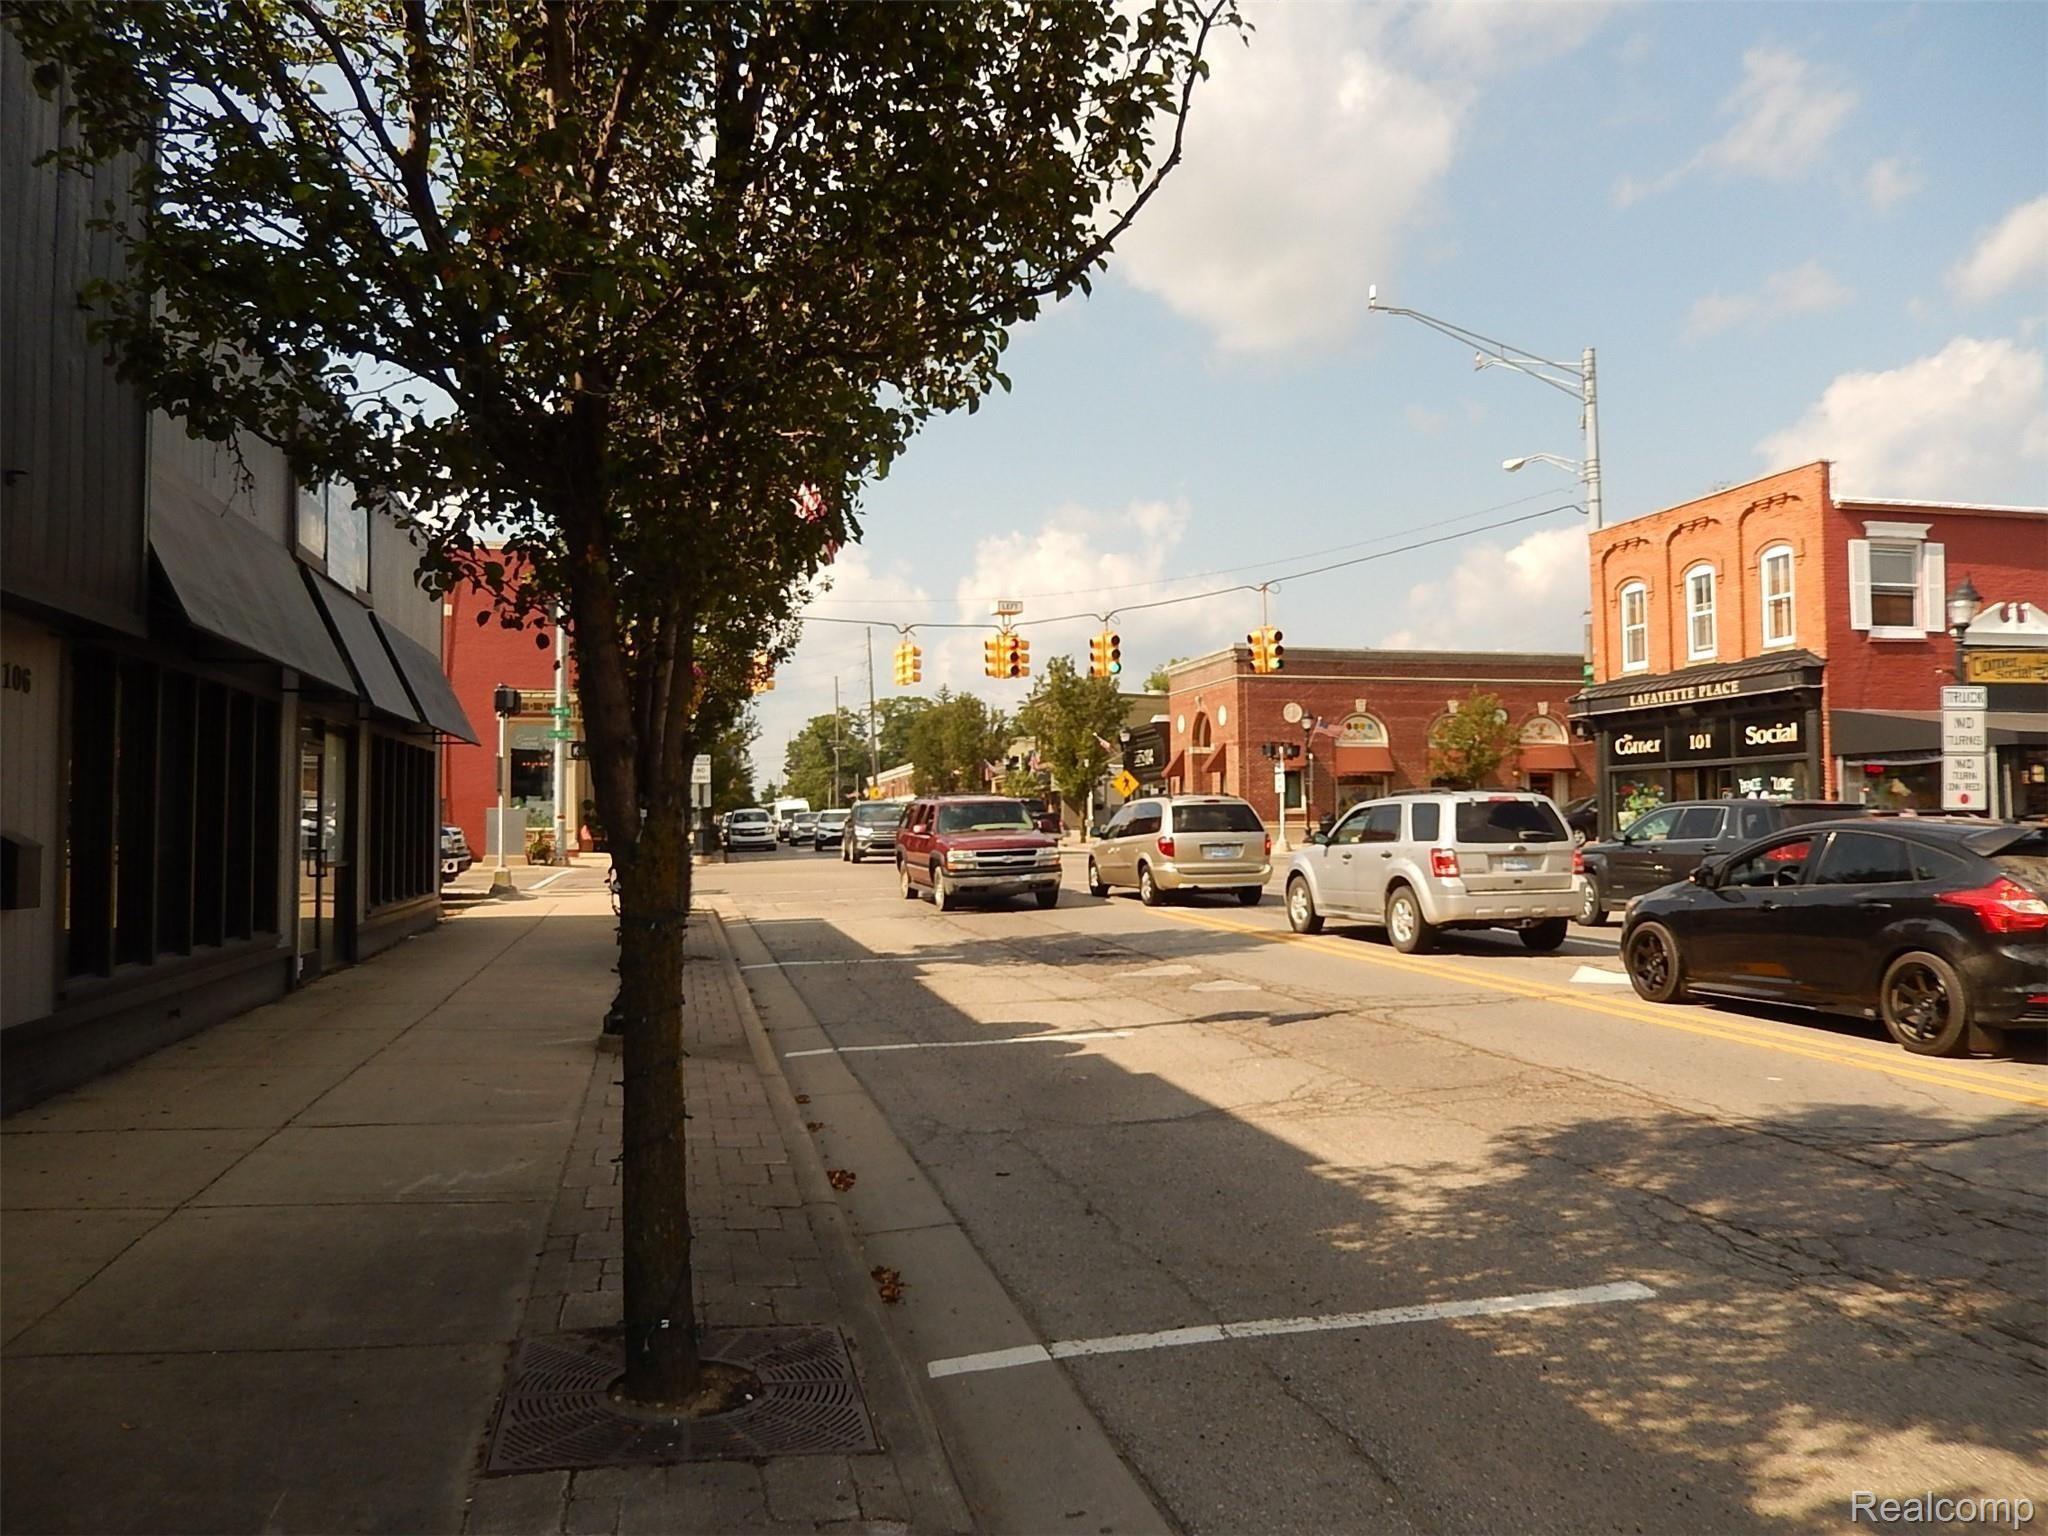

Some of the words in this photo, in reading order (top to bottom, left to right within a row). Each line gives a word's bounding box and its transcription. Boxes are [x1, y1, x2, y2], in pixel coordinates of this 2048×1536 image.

[2, 661, 32, 694] 106
[1629, 686, 1696, 706] LAFAYETTE
[1698, 680, 1740, 698] PLACE
[1945, 691, 1984, 703] TRUCK
[1953, 717, 1975, 729] NO
[1689, 734, 1712, 750] 101
[1745, 722, 1798, 745] Social
[1614, 737, 1661, 756] Corner
[1953, 758, 1975, 769] NO
